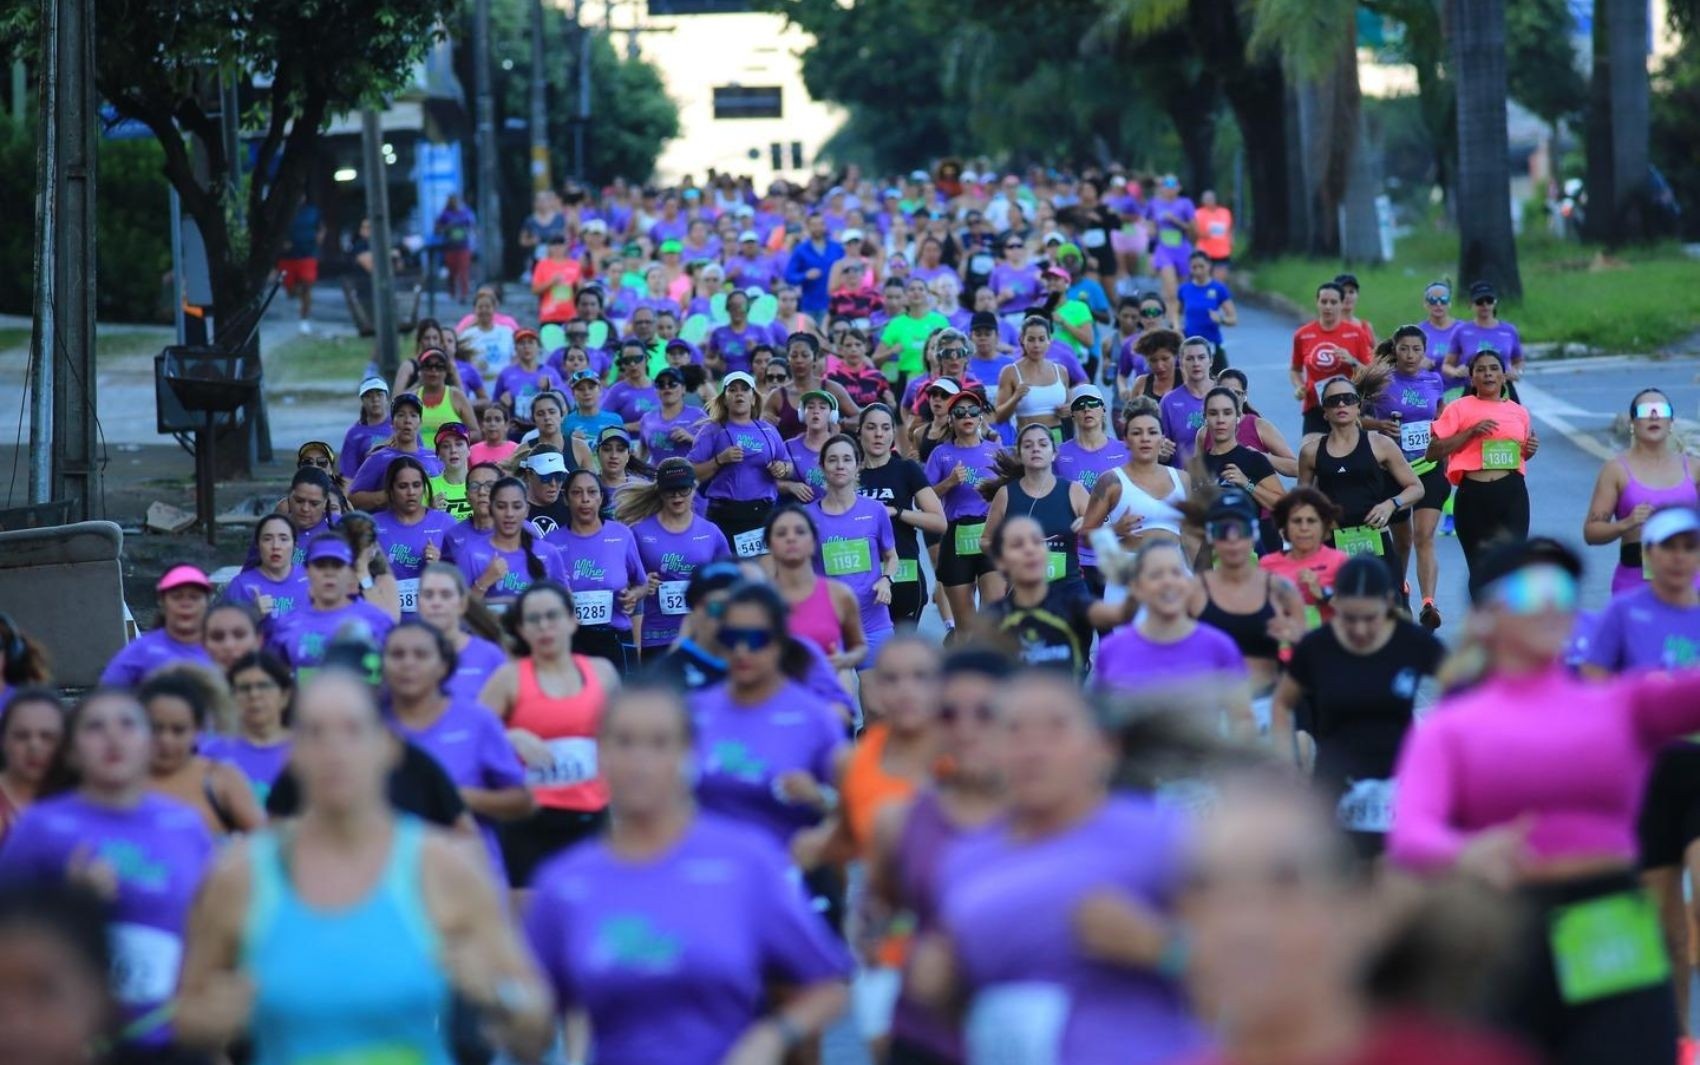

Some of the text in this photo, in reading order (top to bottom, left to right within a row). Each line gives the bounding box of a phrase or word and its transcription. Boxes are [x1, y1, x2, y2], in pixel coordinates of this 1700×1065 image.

[1488, 452, 1514, 465] 1304
[833, 554, 861, 570] 1192
[574, 605, 607, 620] 5285
